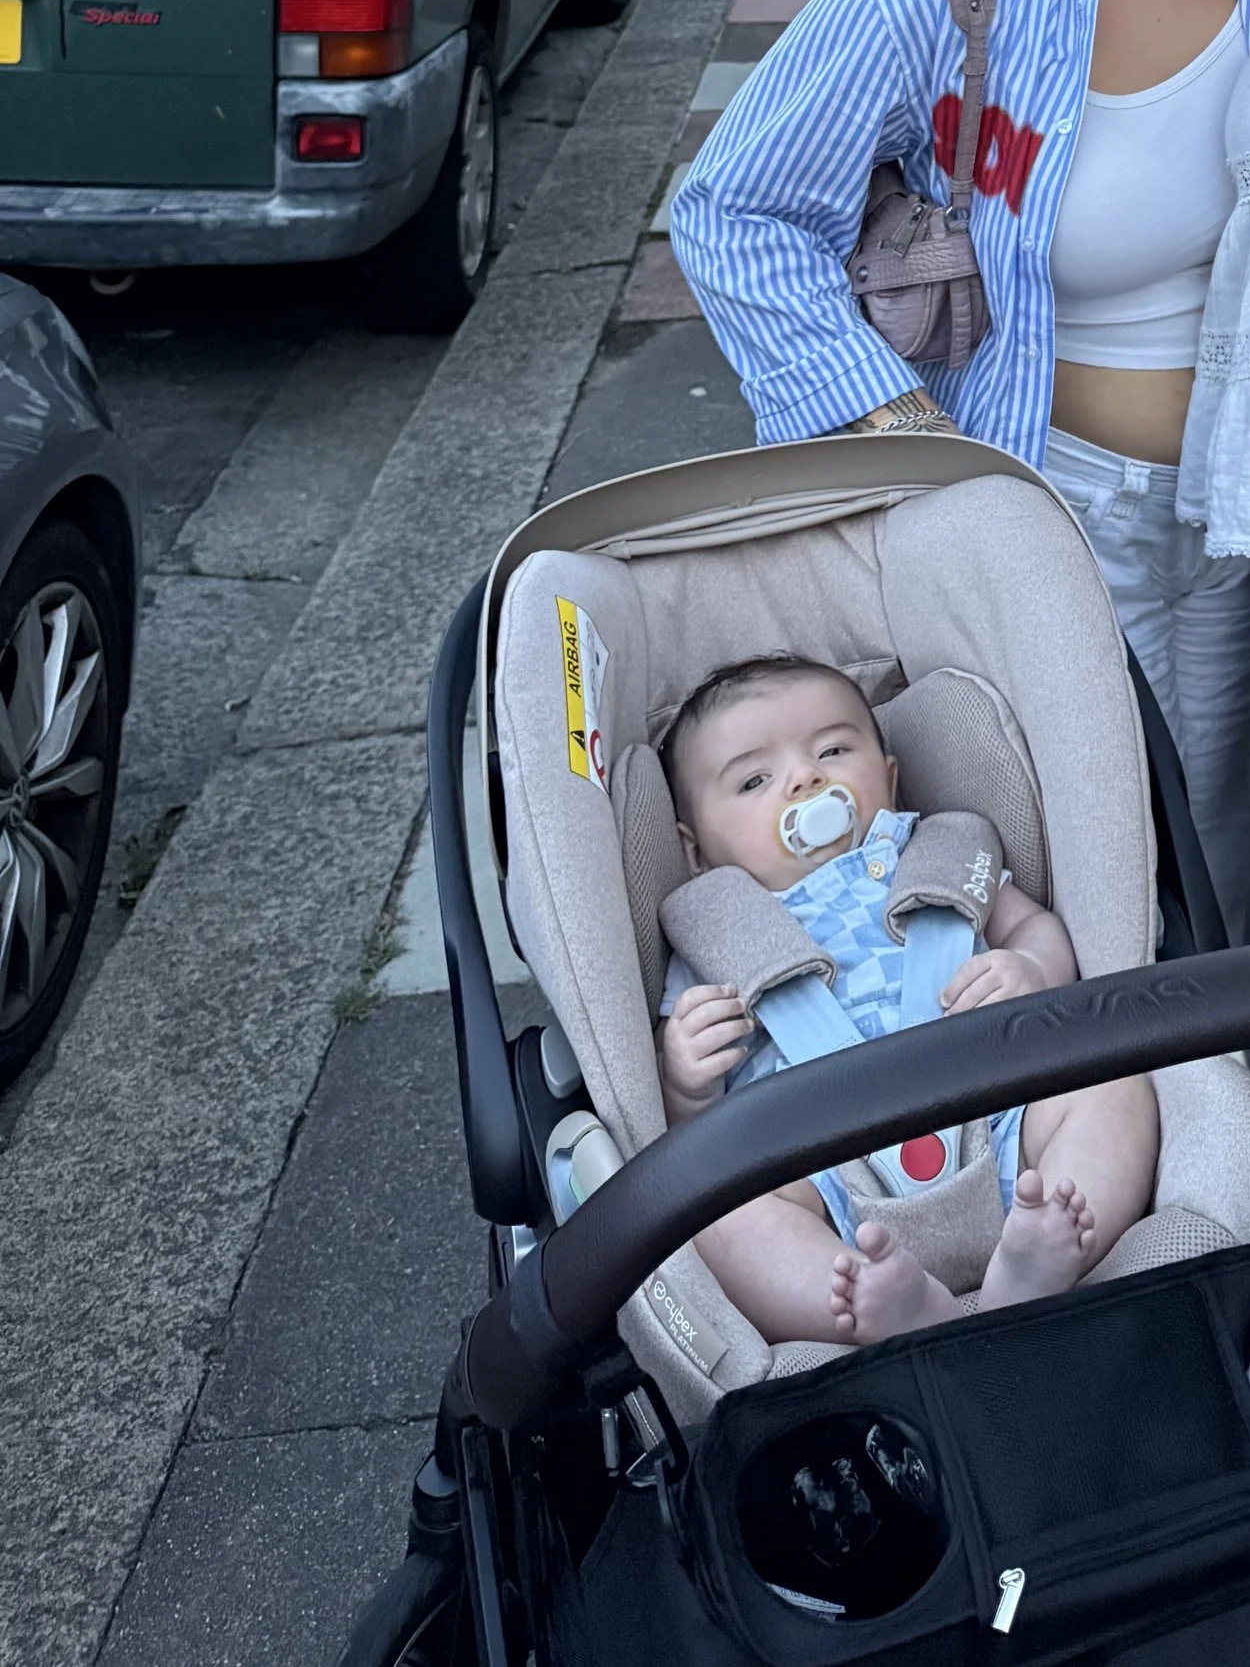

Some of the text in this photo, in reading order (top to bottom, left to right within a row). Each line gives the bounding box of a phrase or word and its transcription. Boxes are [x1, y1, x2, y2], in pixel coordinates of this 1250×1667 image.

[564, 621, 582, 699] AIRBAG
[965, 849, 996, 887] cybex
[664, 1296, 698, 1343] cybex
[670, 1323, 709, 1371] PLATINUM
